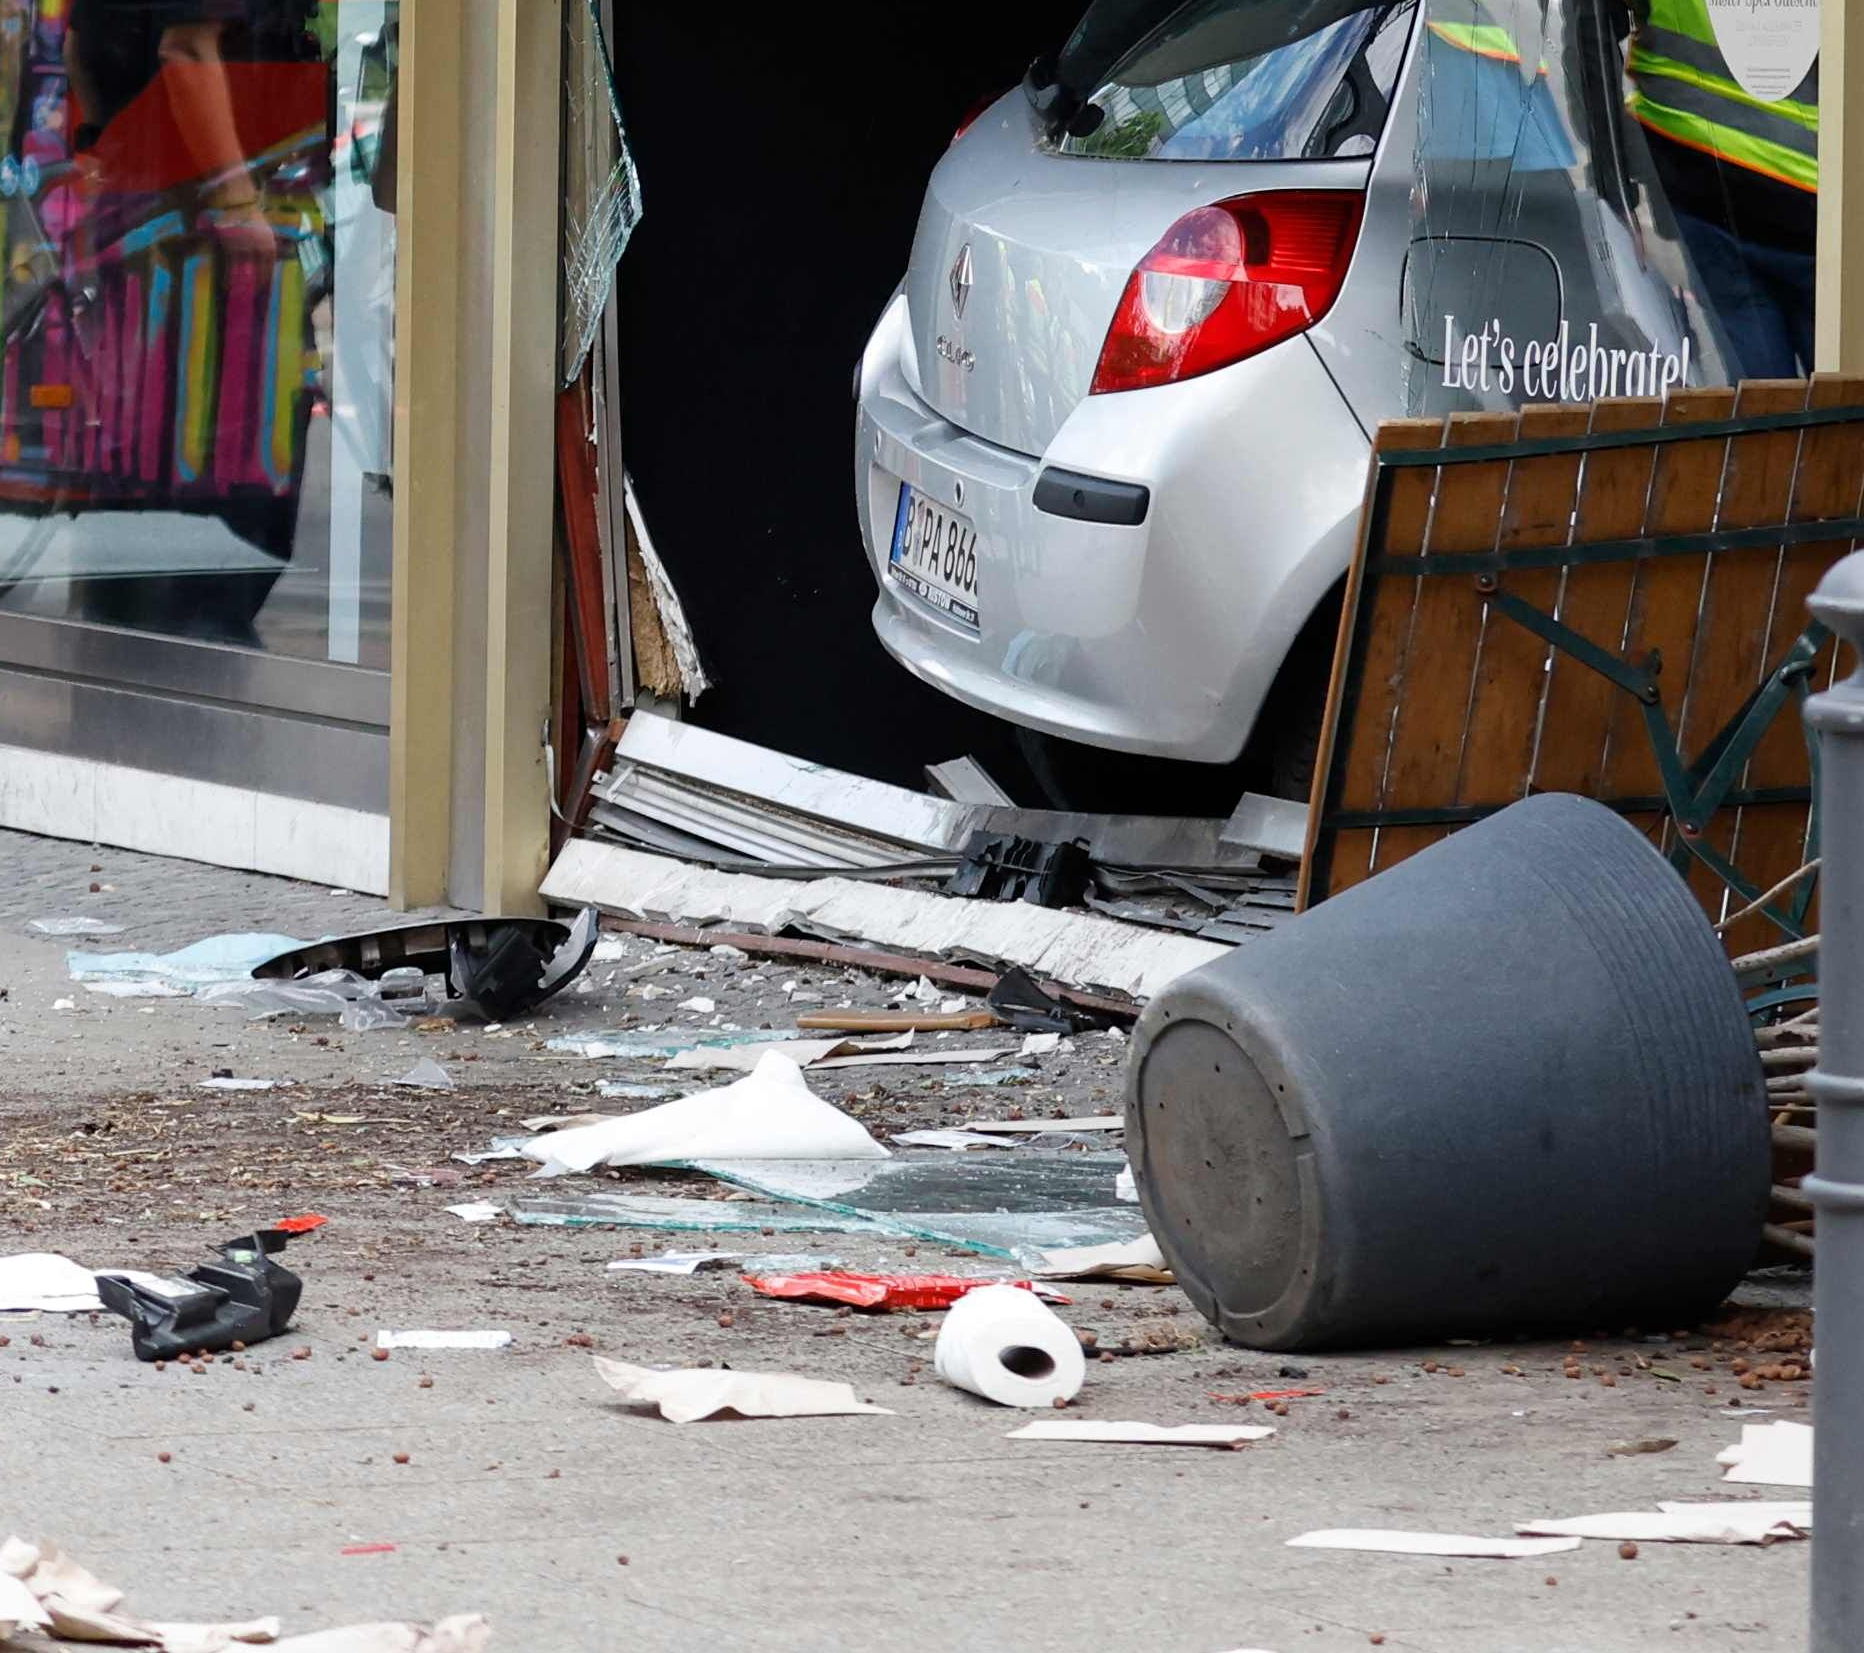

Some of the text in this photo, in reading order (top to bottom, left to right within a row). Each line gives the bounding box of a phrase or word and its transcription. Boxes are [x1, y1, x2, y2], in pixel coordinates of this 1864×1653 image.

[1442, 314, 1691, 404] Let's celebrate!
[903, 496, 916, 556] B
[919, 507, 943, 576] PA
